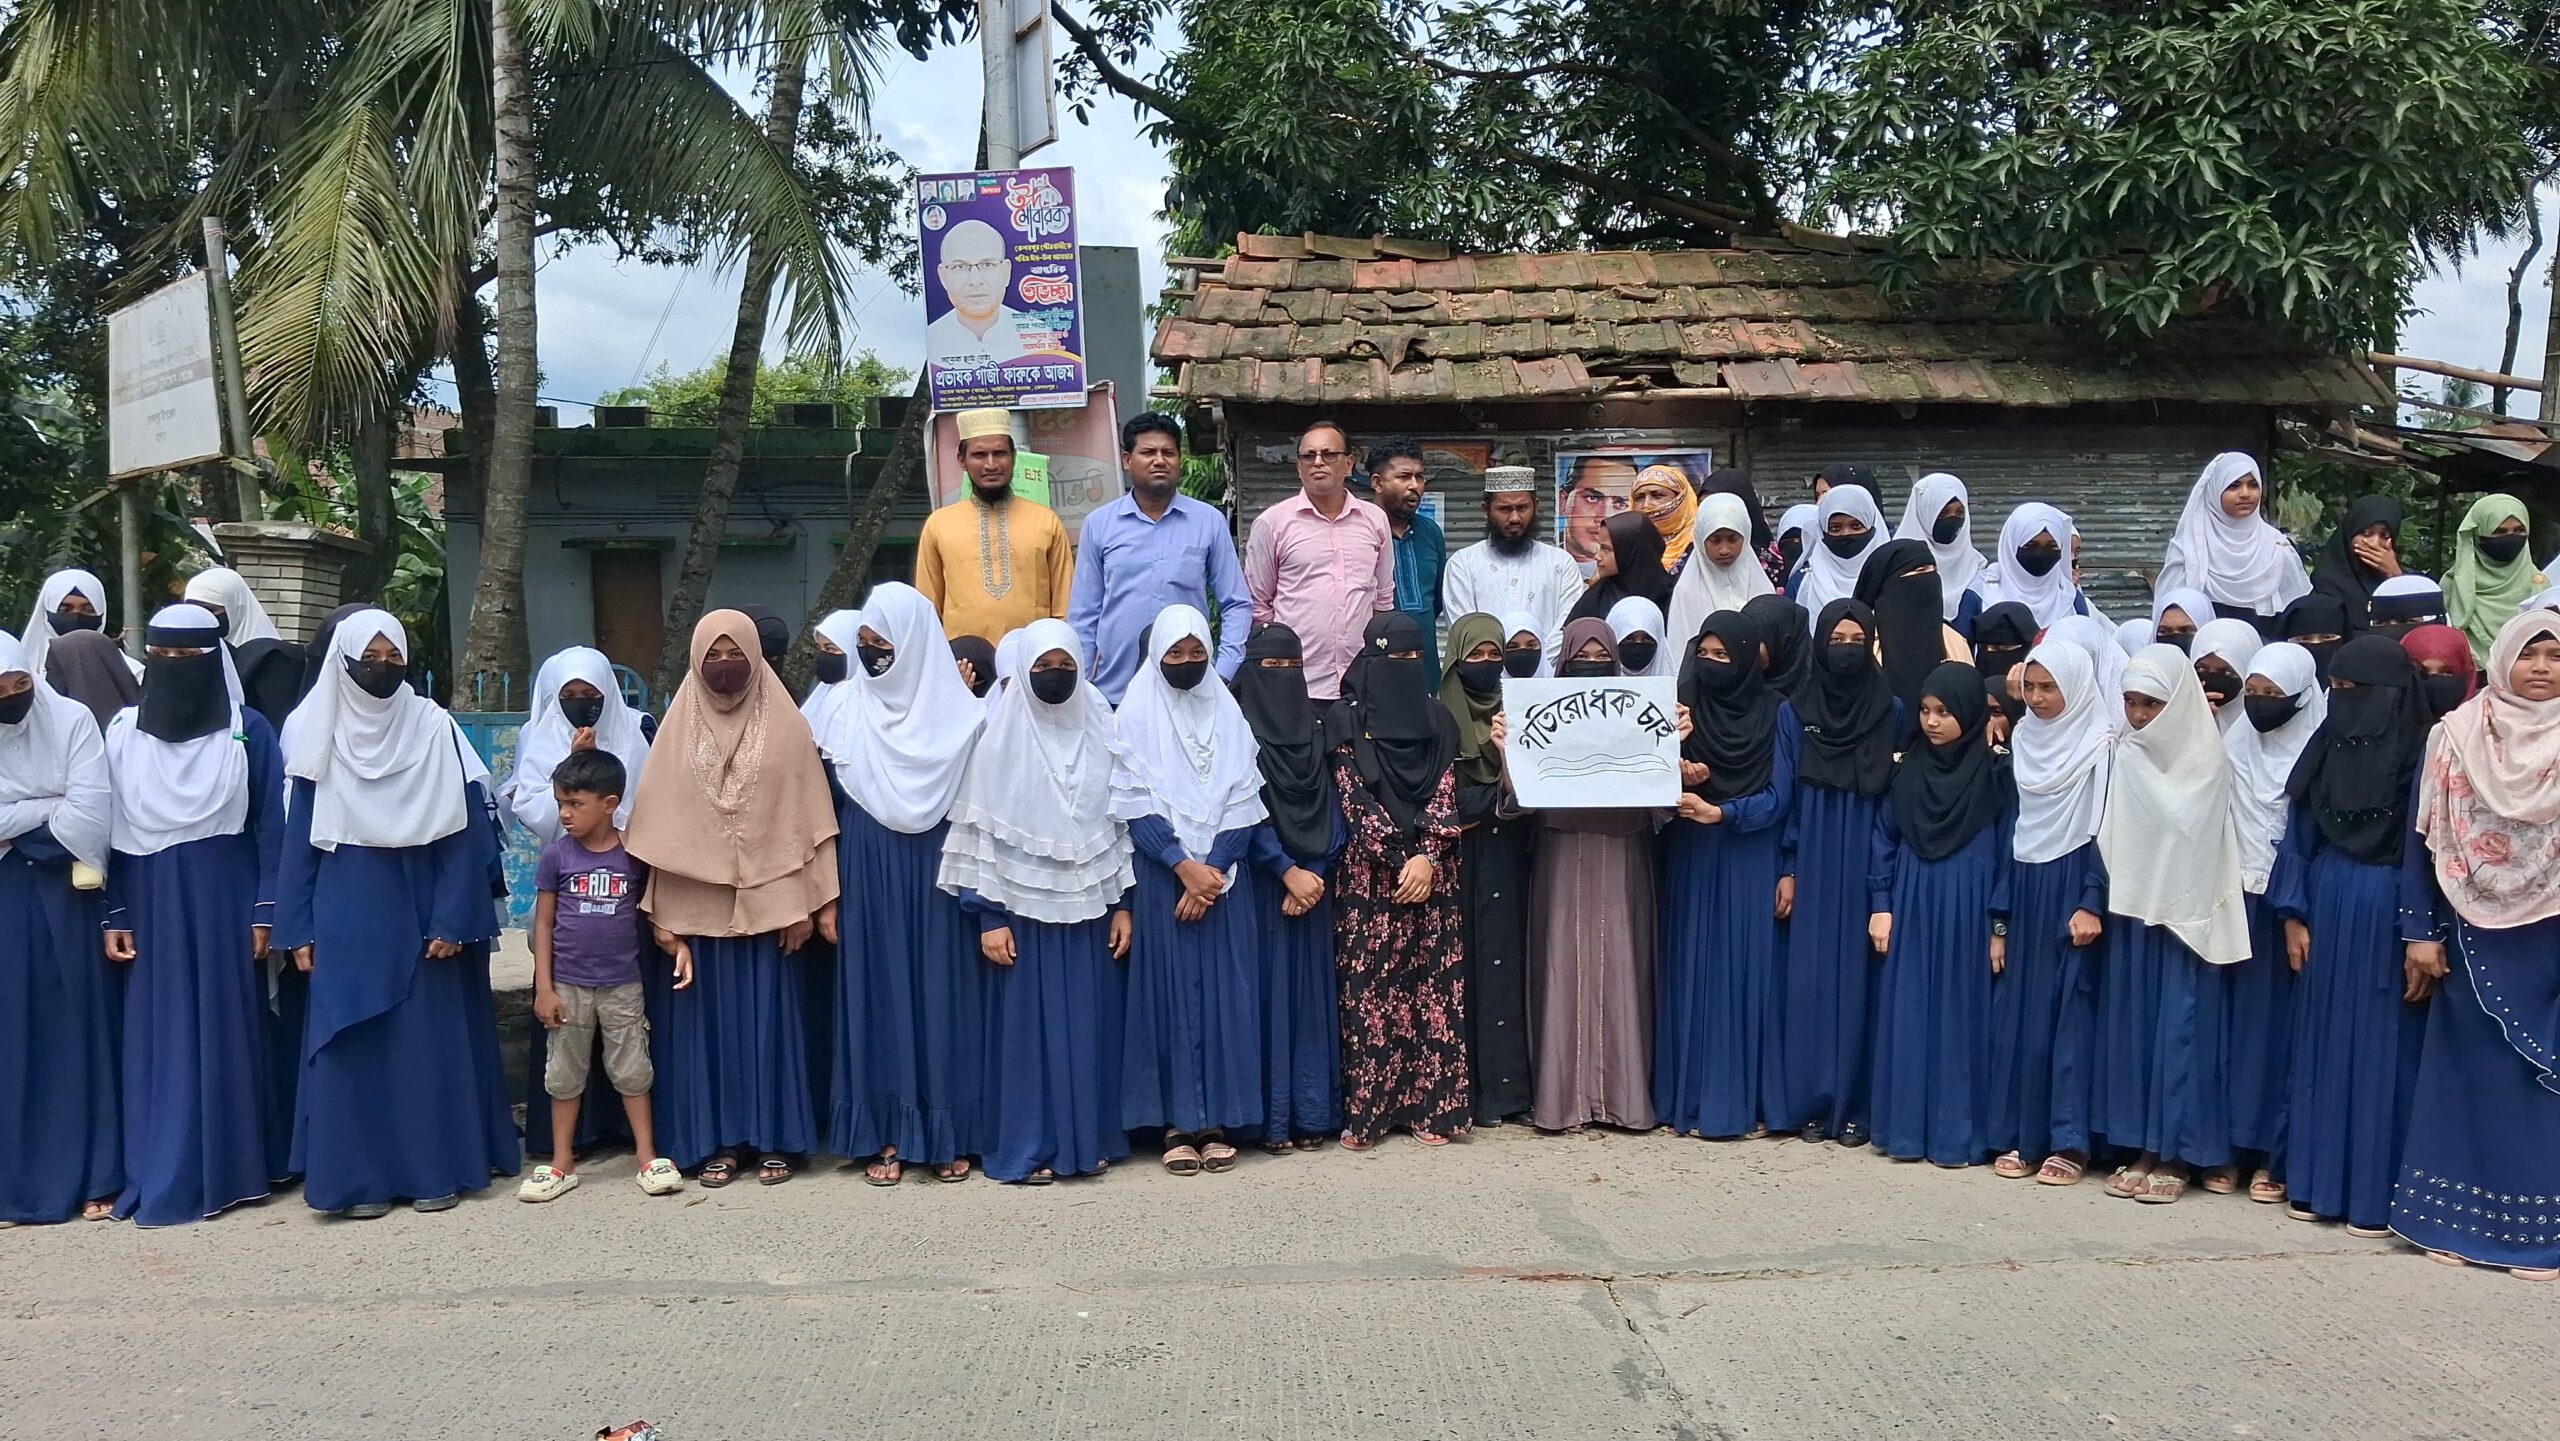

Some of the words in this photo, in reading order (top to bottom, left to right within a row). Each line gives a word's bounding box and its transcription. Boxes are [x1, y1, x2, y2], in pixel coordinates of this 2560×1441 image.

[1013, 205, 1069, 238] মোবারক
[1030, 264, 1067, 274] আন্তরিক
[1020, 276, 1073, 304] শুভেচ্ছা
[936, 367, 973, 388] প্রভাষক
[975, 361, 1000, 386] গাজী
[1002, 365, 1040, 384] ফারুকে
[1043, 364, 1075, 382] আজম
[1519, 689, 1641, 749] গতিরোধক
[1637, 701, 1676, 747] চাই
